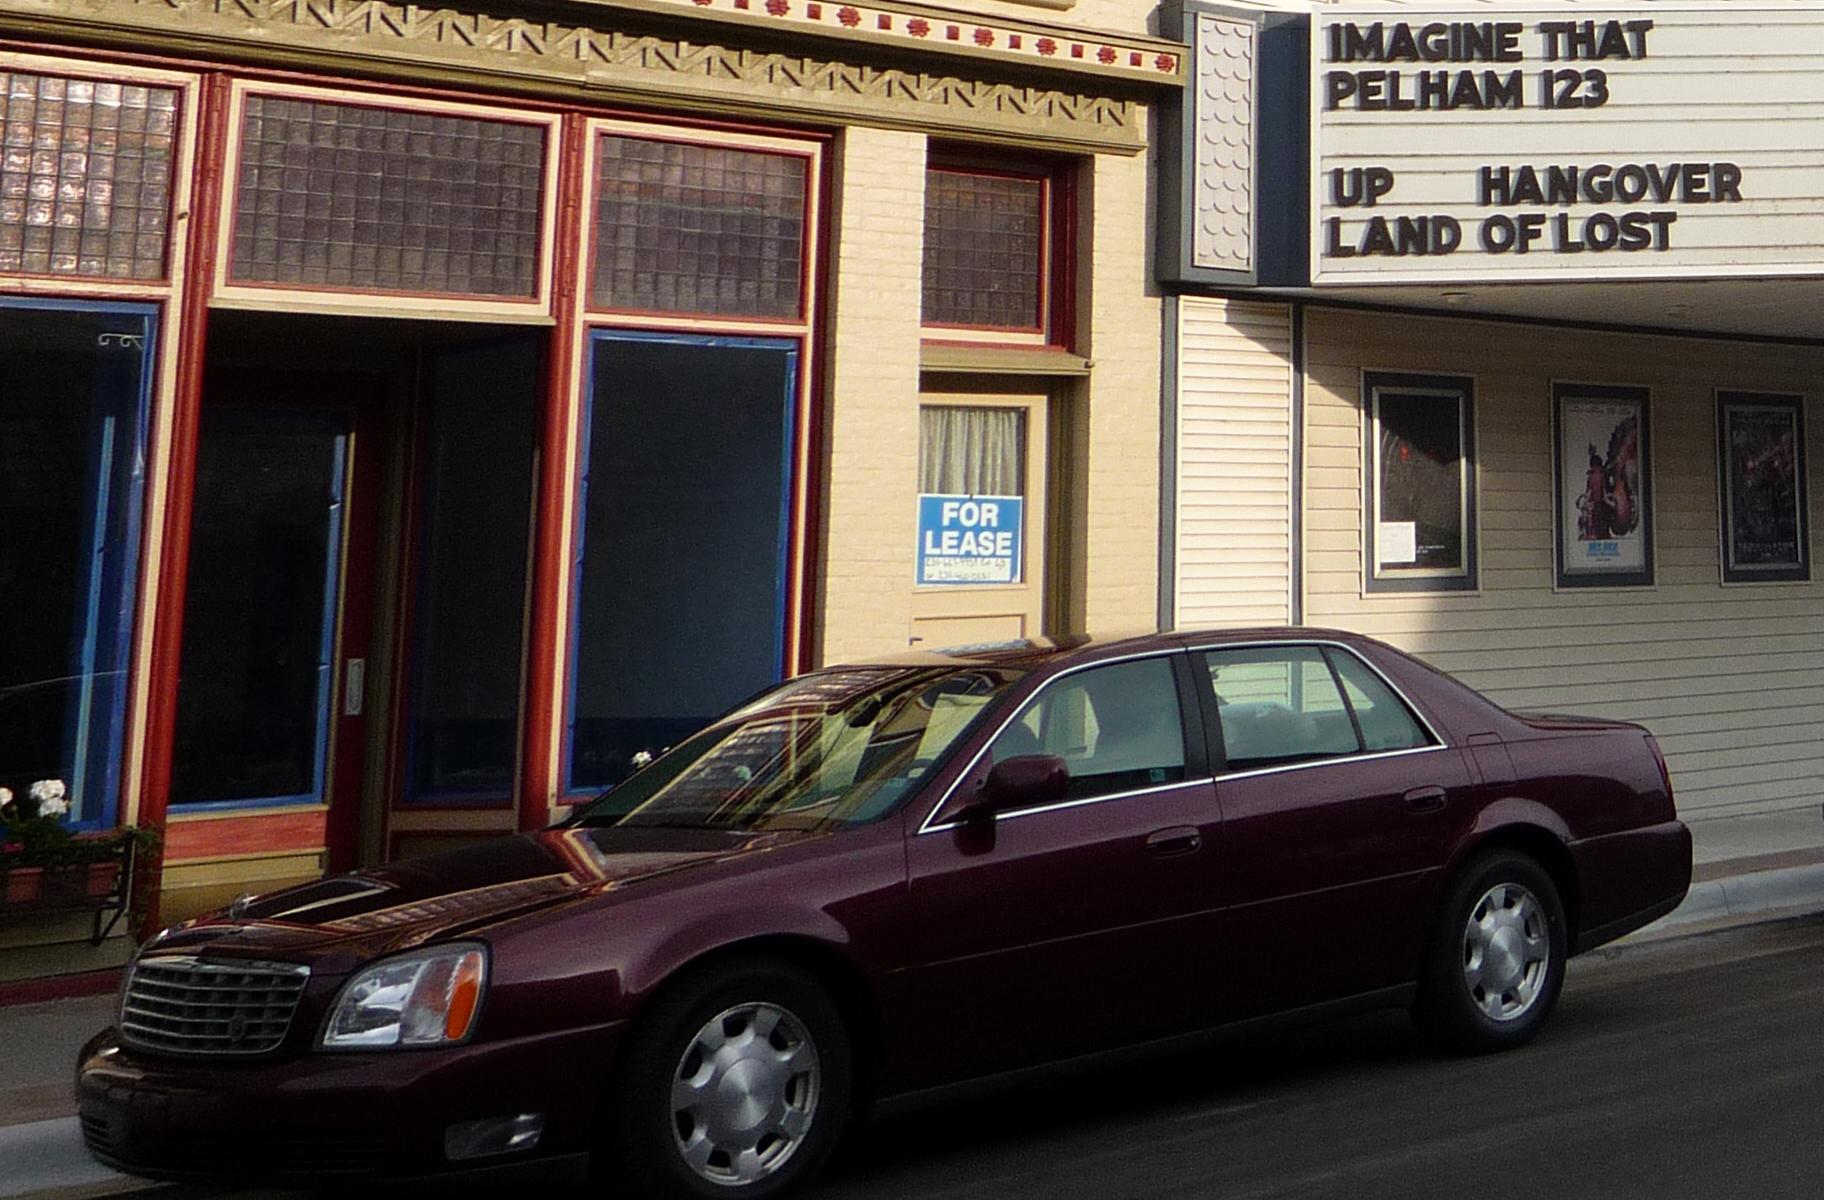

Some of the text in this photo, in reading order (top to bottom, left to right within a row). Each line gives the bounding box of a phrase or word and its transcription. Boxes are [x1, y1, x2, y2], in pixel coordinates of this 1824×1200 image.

[1330, 20, 1653, 63] IMAGINE THAT
[1329, 69, 1609, 111] PELHAM 123
[1333, 162, 1743, 207] UP HANGOVER
[1328, 211, 1677, 258] LAND OF LOST
[942, 502, 999, 527] FOR
[925, 530, 1013, 556] LEASE
